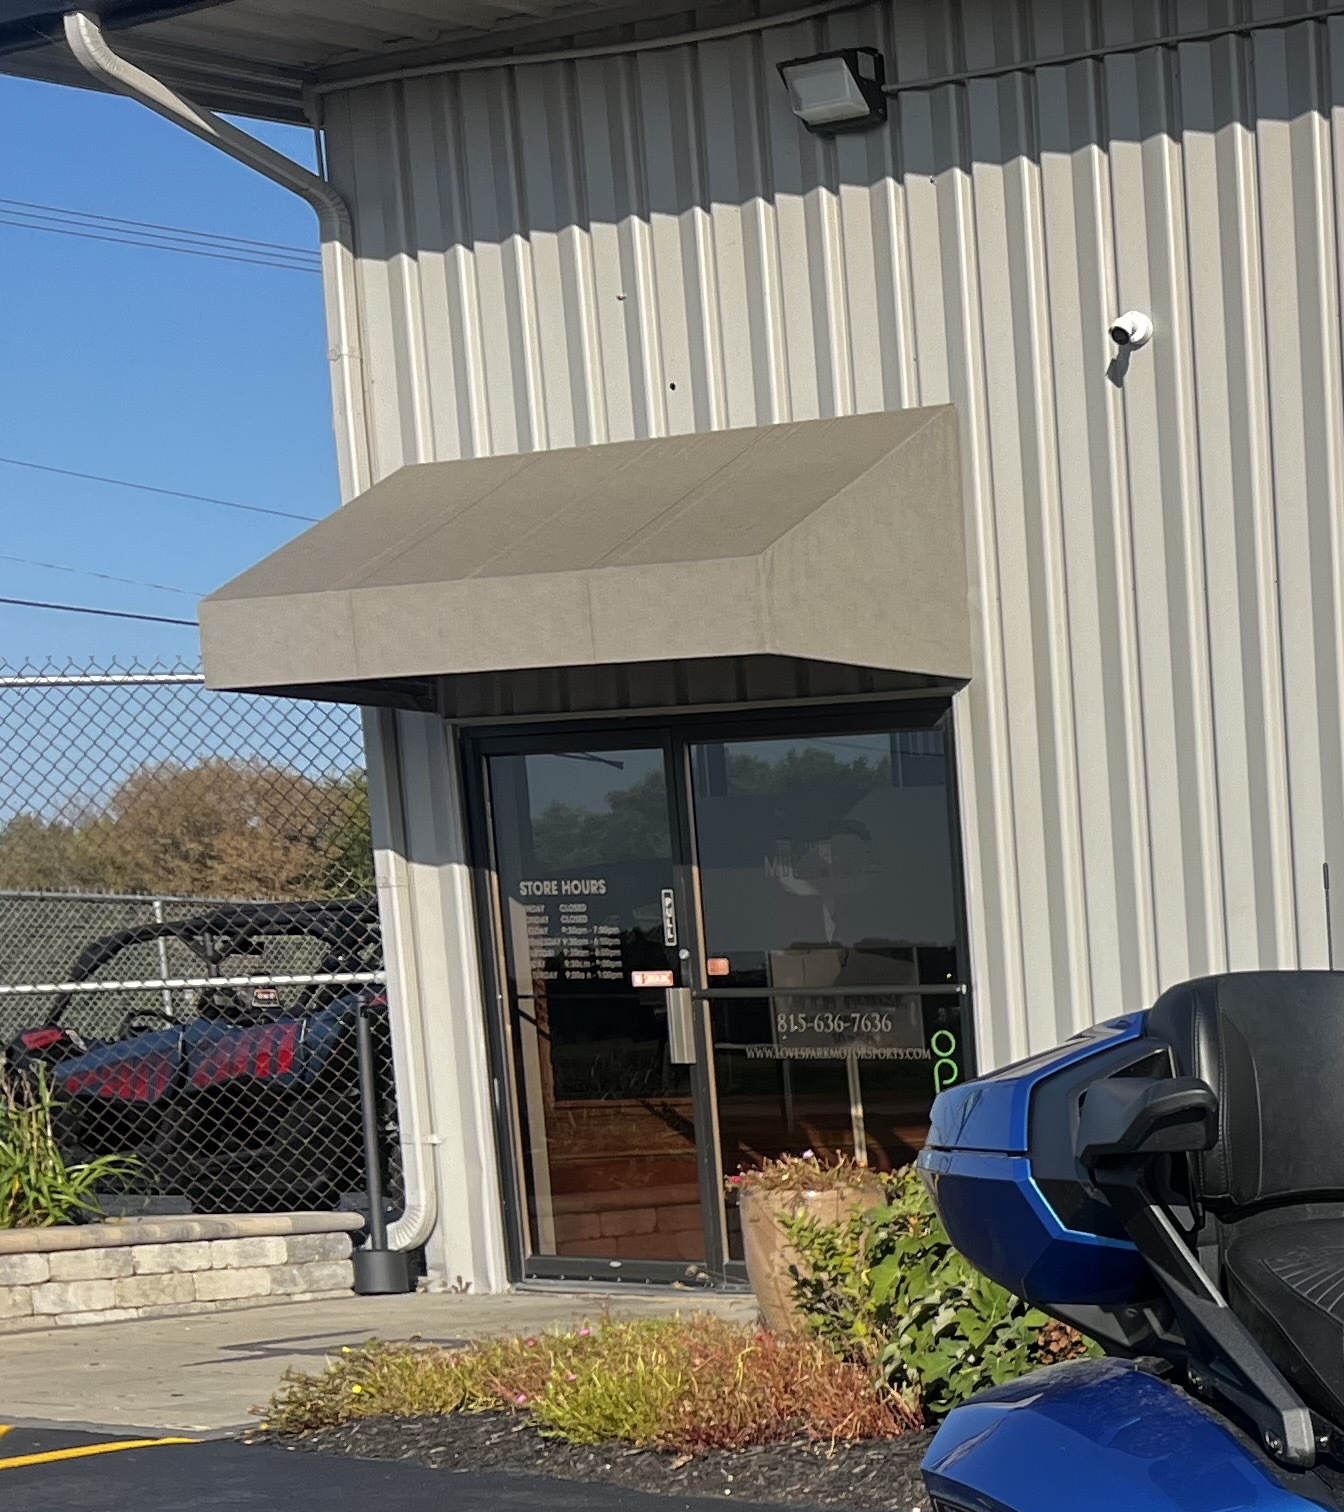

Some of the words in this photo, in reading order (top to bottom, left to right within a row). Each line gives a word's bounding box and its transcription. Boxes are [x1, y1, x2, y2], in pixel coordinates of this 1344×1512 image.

[519, 880, 559, 896] STORE
[561, 879, 607, 895] HOURS
[777, 1013, 892, 1033] 815-636-7636
